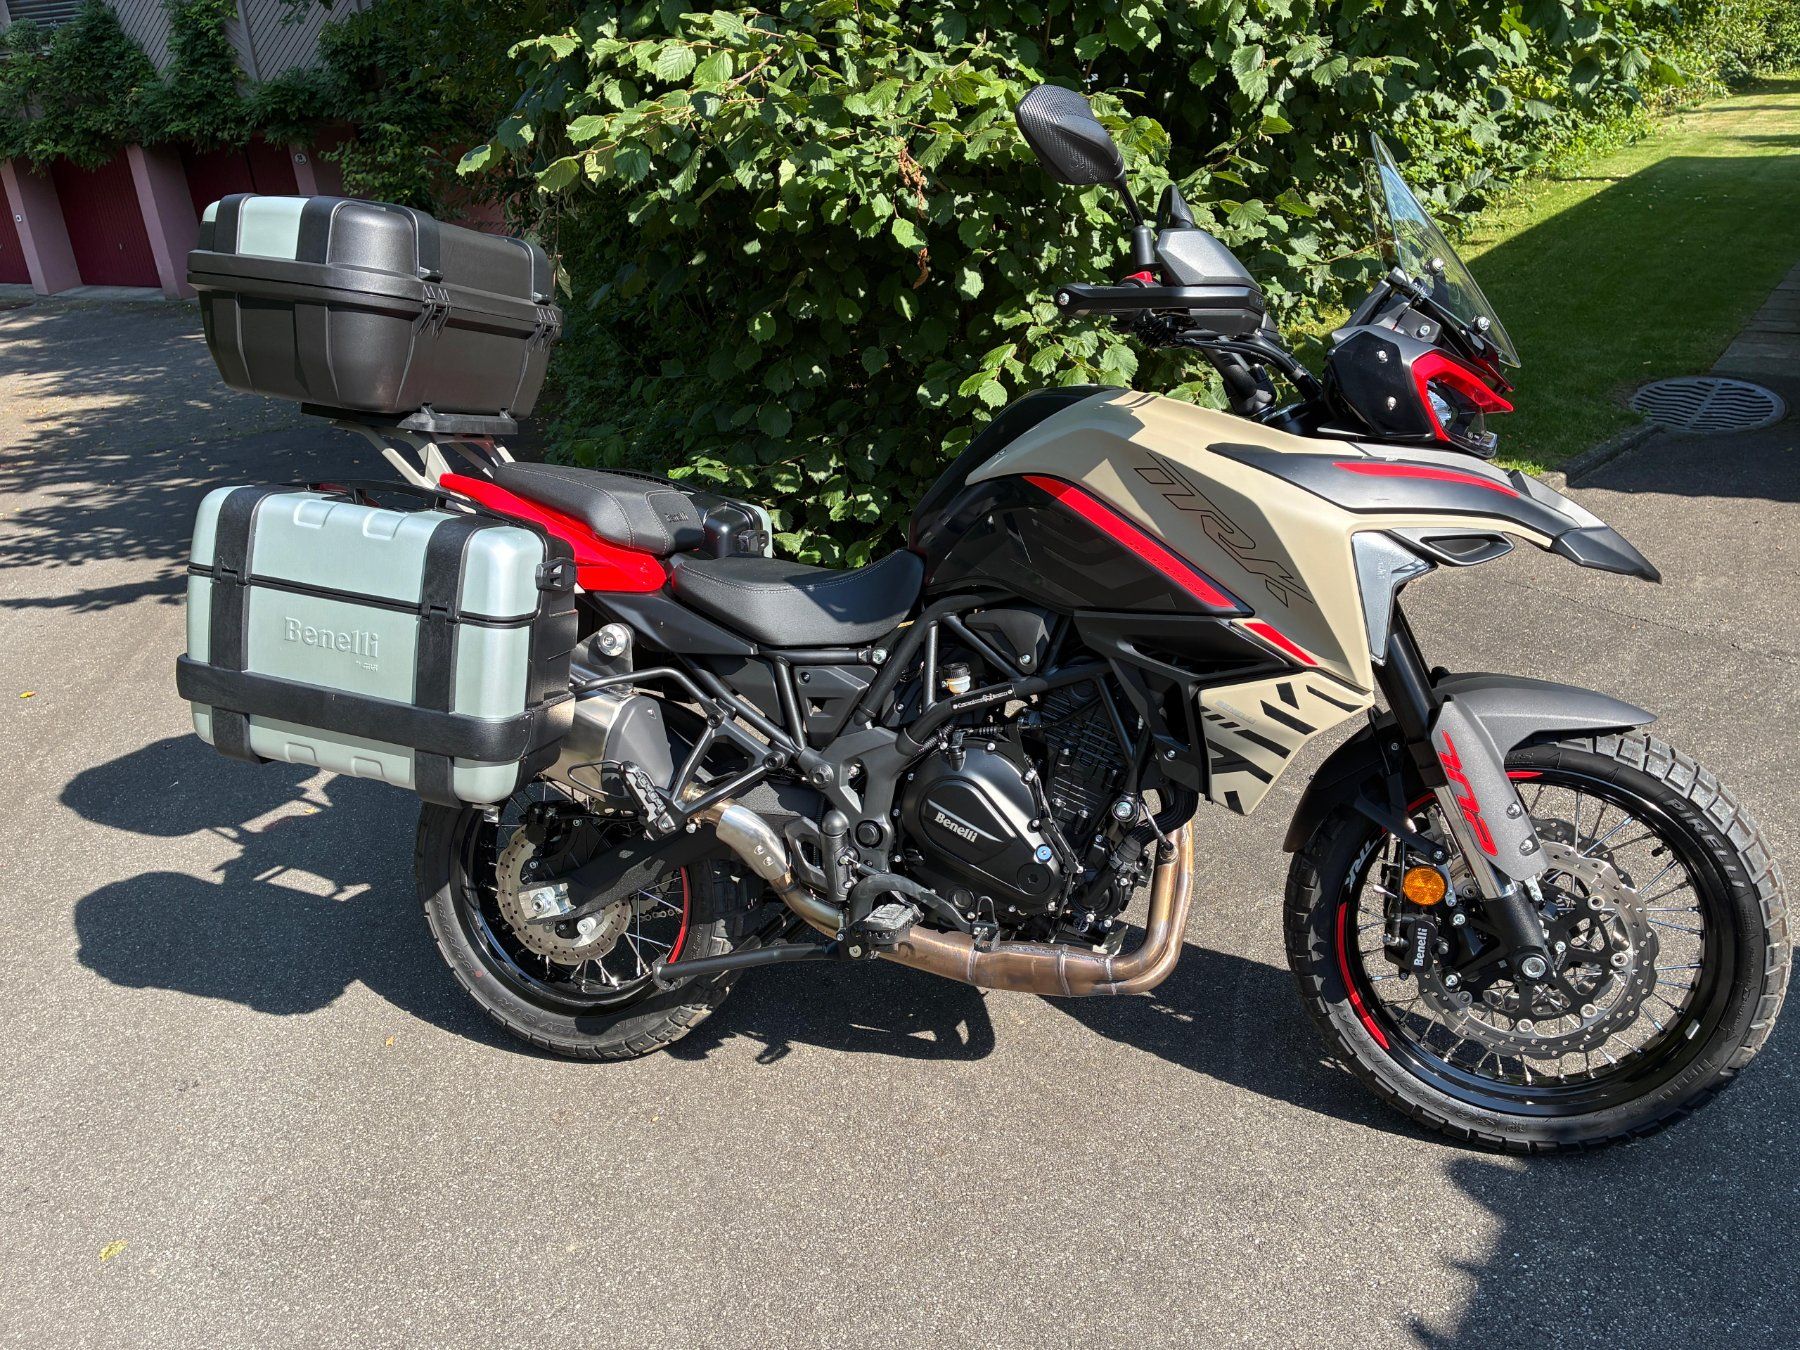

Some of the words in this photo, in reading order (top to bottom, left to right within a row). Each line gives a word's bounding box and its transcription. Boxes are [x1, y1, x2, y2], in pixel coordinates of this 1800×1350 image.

[284, 616, 379, 658] Benelli
[934, 811, 978, 843] Benelli
[1662, 799, 1745, 888] PIRELLI
[1414, 927, 1428, 967] Benelli
